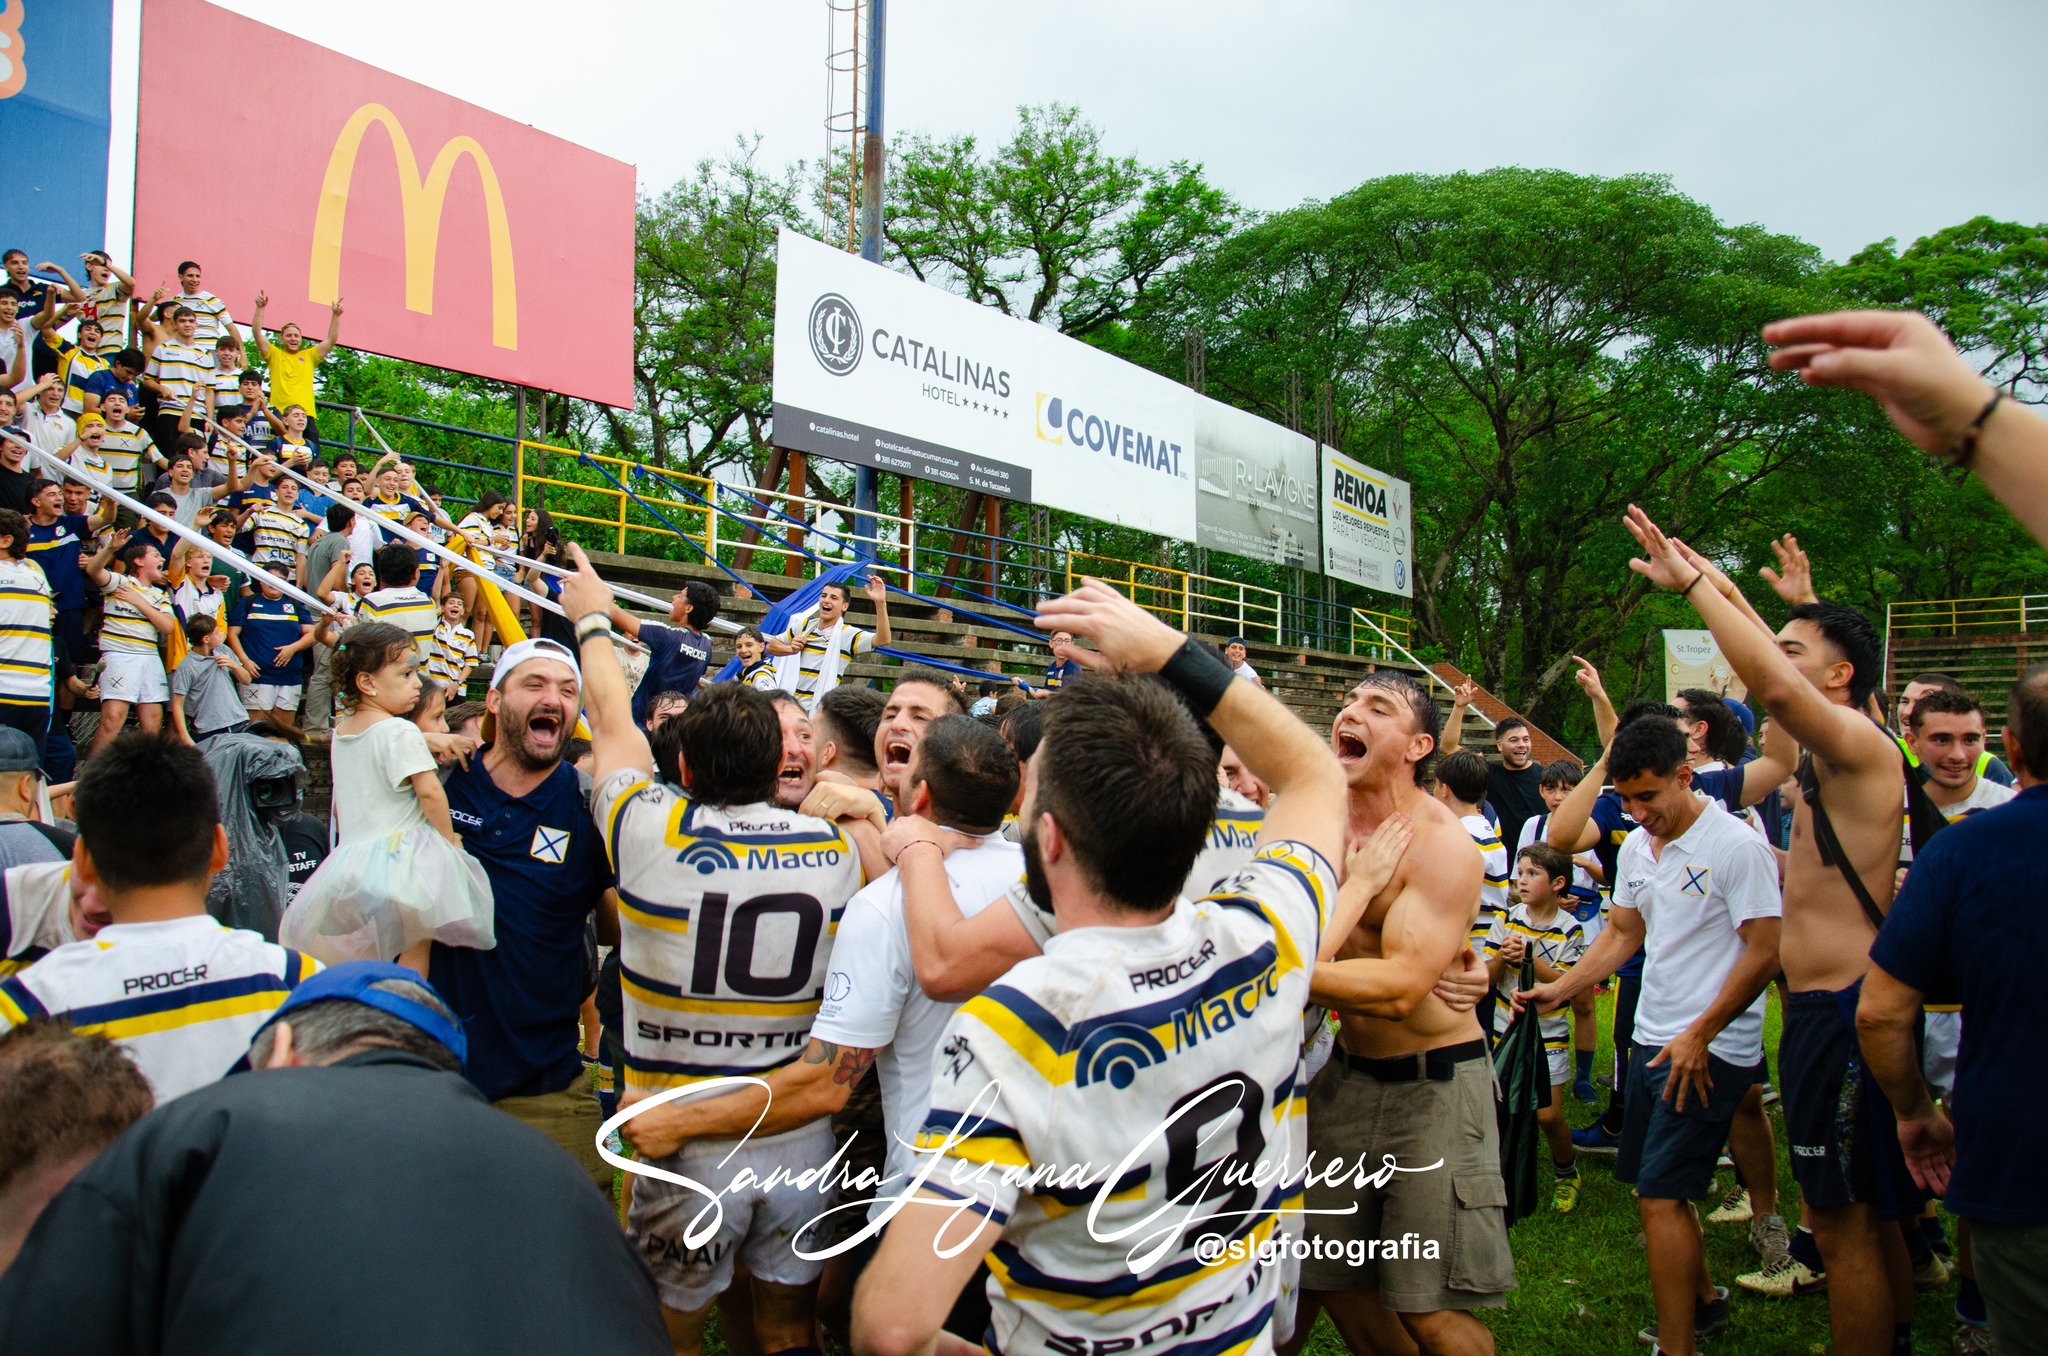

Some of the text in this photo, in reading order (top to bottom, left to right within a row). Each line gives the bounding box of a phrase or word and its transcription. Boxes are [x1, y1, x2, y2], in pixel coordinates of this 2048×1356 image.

[872, 328, 1011, 398] CATALINAS
[922, 383, 961, 407] HOTEL
[816, 425, 860, 442] catalinas.hotel
[1067, 408, 1181, 477] COVEMAT
[1333, 468, 1388, 519] RENOA
[1332, 509, 1390, 539] LOS MEJORES REPUESTOS
[1332, 521, 1349, 540] PARA
[1351, 528, 1359, 543] TU
[288, 859, 317, 873] STAFF
[293, 851, 307, 861] TV
[747, 847, 840, 871] Macro
[690, 891, 824, 997] 10
[123, 963, 208, 995] PROCER
[1129, 938, 1217, 993] PROCER
[1170, 963, 1279, 1055] Macro
